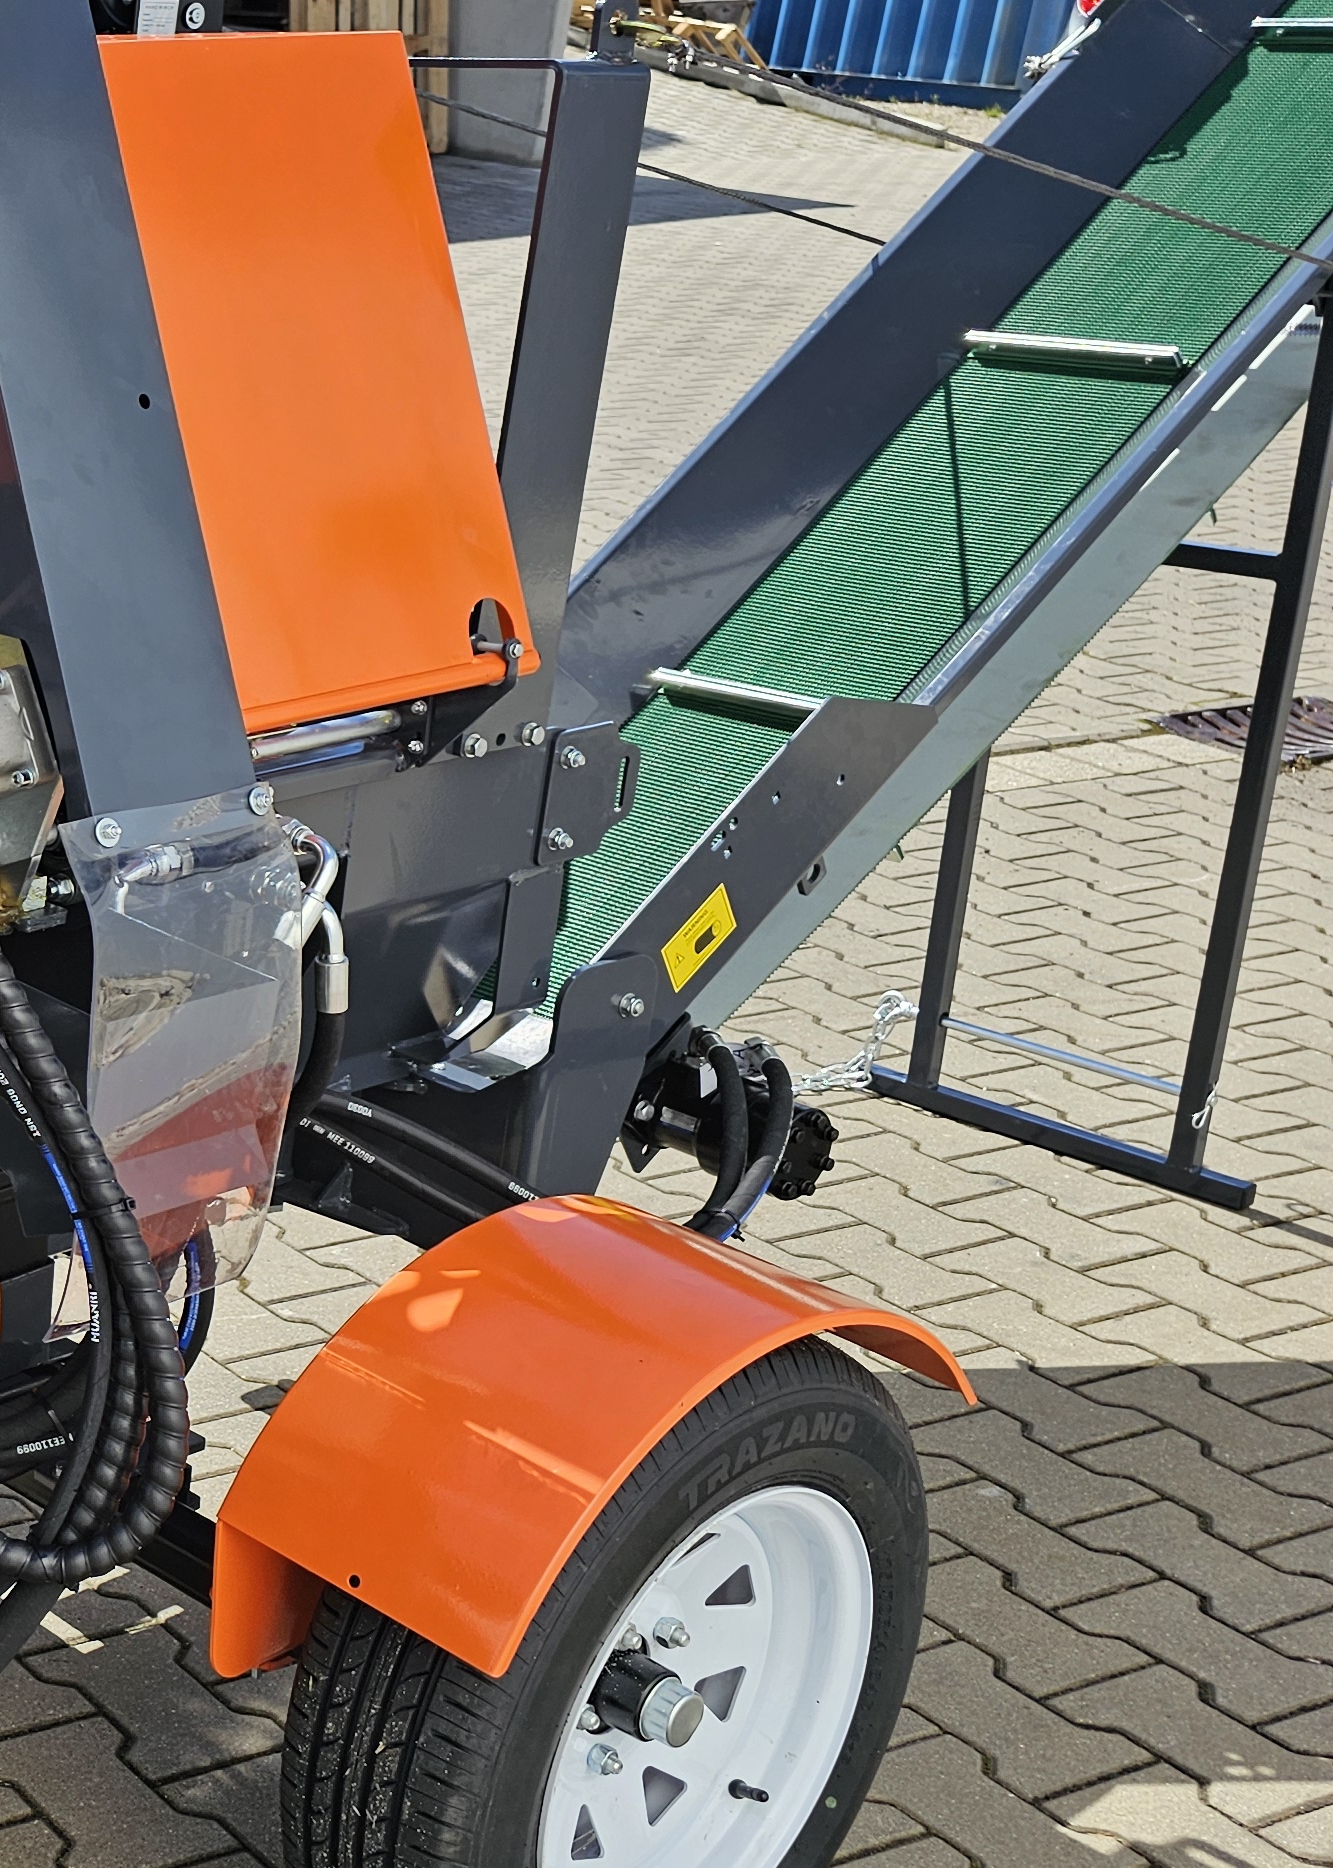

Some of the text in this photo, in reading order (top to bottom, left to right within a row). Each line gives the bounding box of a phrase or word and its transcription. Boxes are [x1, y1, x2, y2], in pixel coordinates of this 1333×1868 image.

[90, 1291, 101, 1343] HUANRI
[16, 1432, 74, 1455] EE110099
[678, 1411, 857, 1510] TRAZANO
